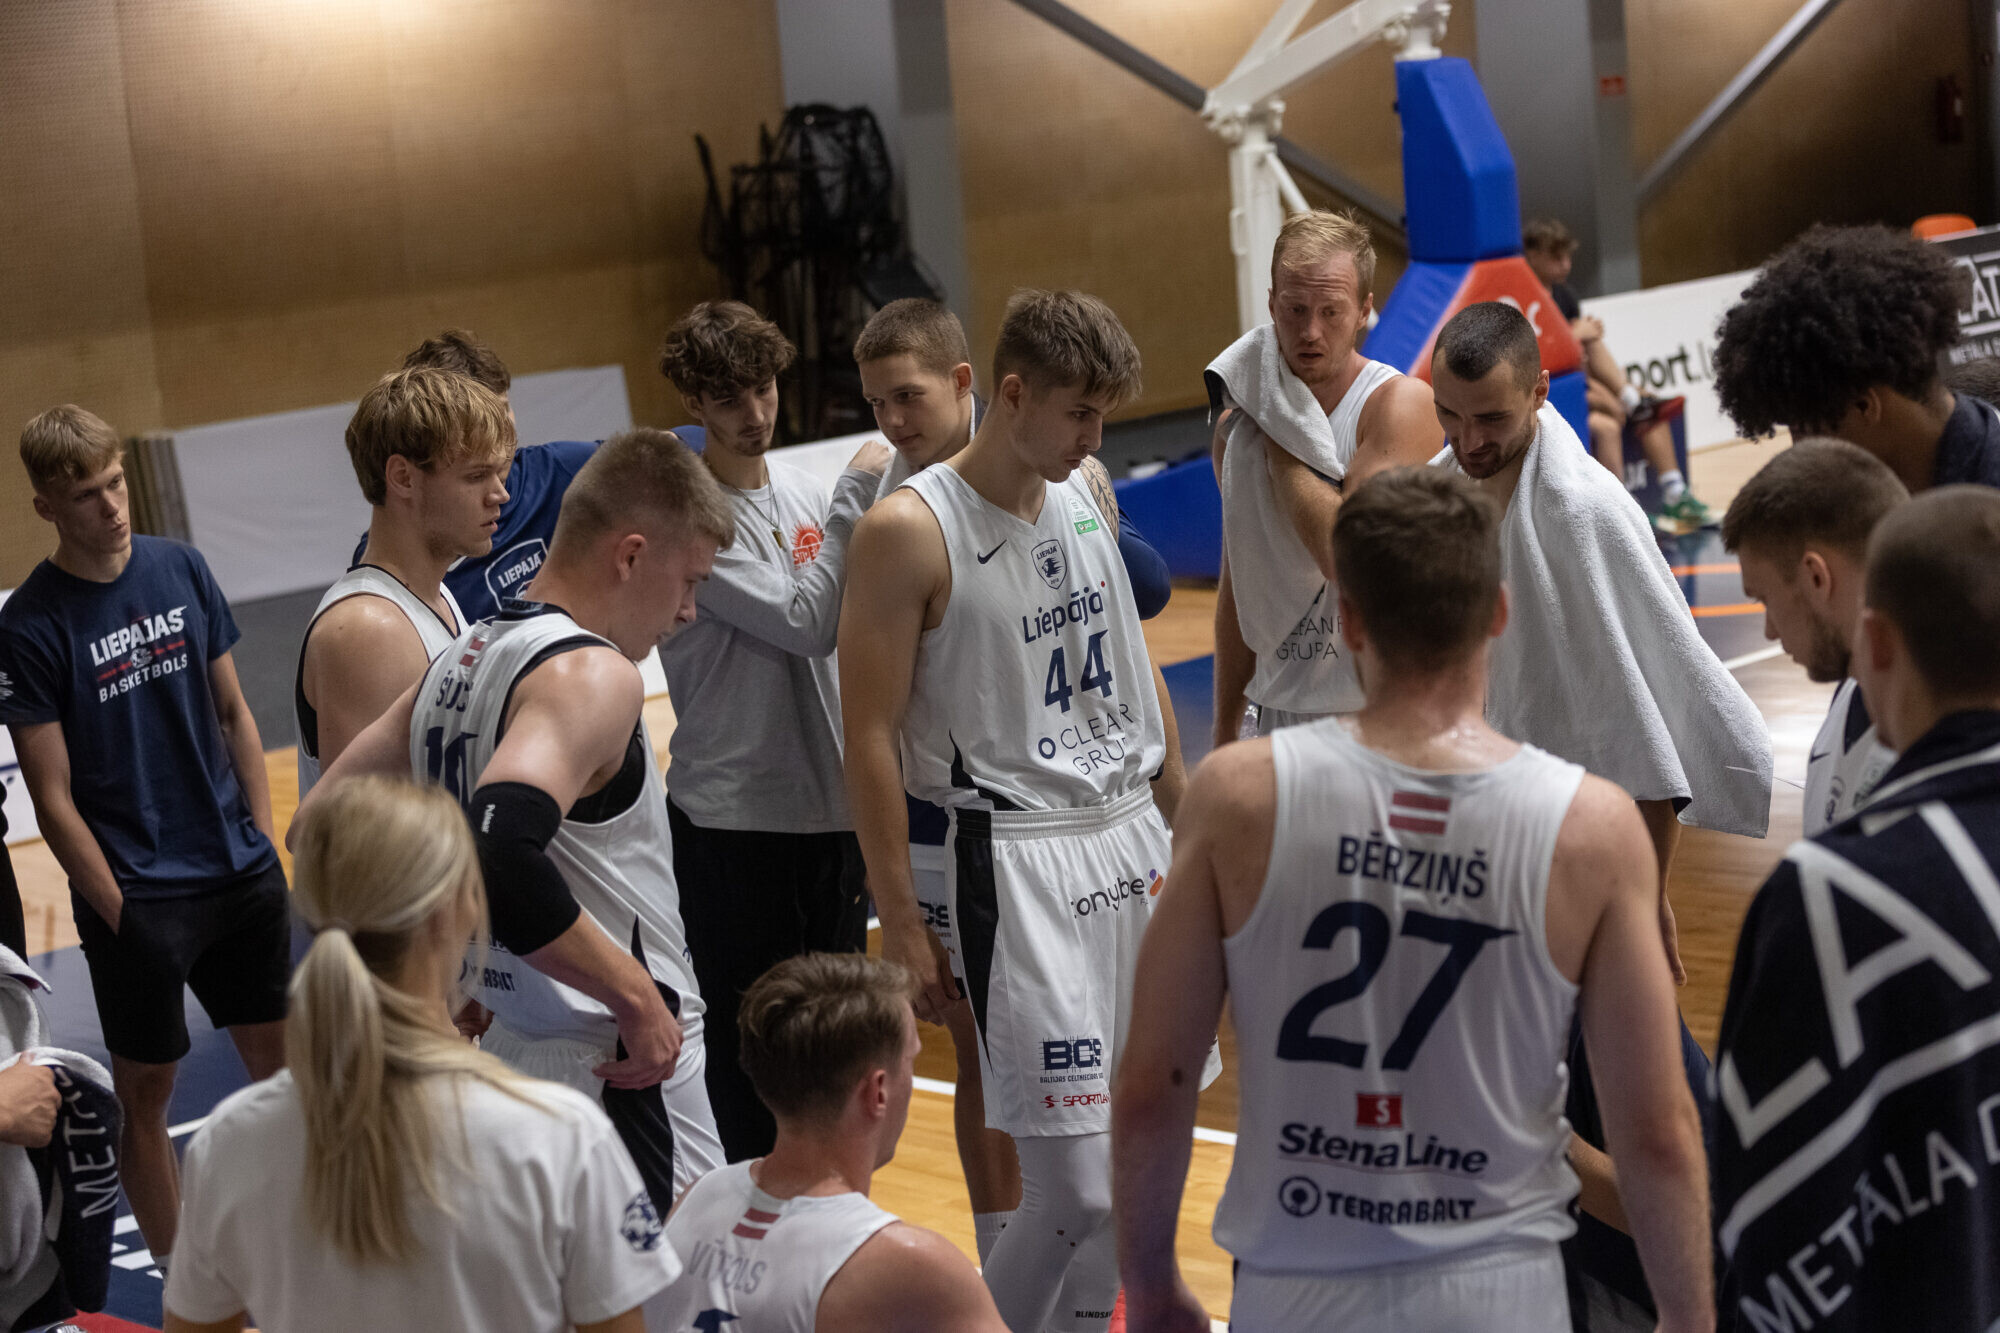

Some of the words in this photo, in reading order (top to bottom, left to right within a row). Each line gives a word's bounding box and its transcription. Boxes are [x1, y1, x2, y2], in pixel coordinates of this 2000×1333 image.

[98, 653, 188, 704] BASKETBOLS
[1045, 629, 1113, 714] 44
[1072, 738, 1127, 776] GRU
[1275, 901, 1518, 1072] 27
[1326, 1191, 1476, 1226] TERRABALT
